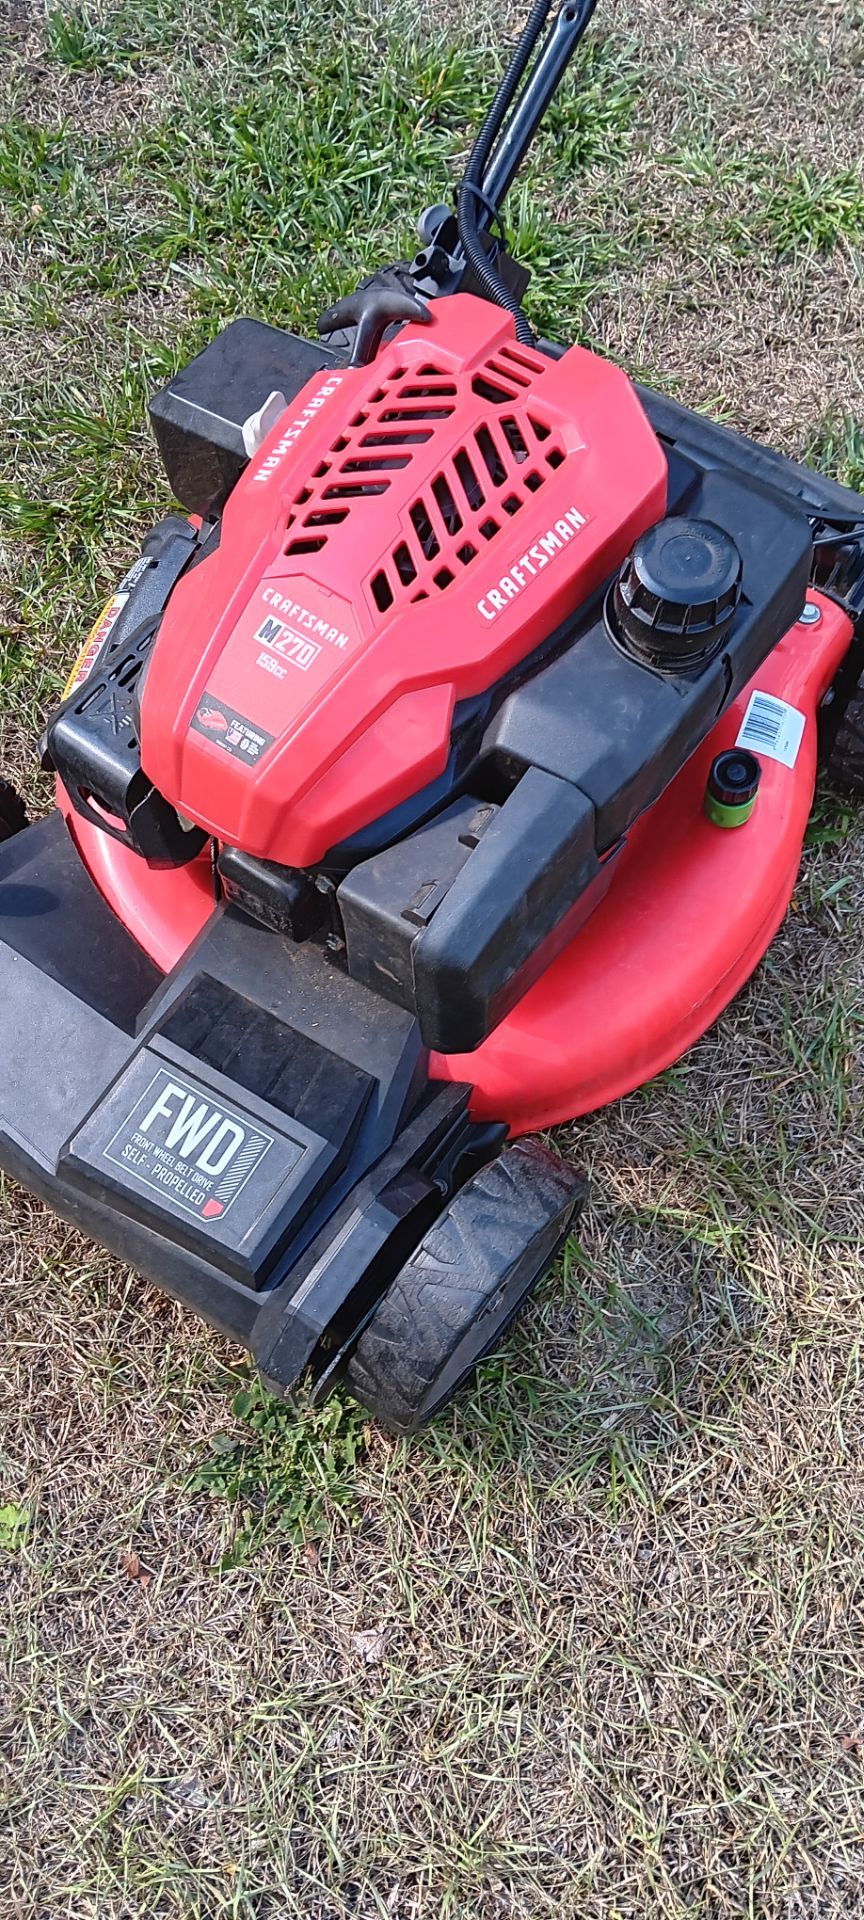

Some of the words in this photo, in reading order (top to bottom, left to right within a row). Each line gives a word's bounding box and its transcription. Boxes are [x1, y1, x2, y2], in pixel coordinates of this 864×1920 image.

[253, 377, 343, 481] CRAFTSMAN
[477, 506, 586, 620] CRAFTSMAN
[74, 607, 120, 682] DANGER
[262, 588, 349, 650] CRAFTSMAN
[131, 1132, 154, 1153] FRONT
[153, 1145, 175, 1167] WHEEL
[174, 1160, 195, 1177] BELT
[191, 1172, 214, 1192] DRIVE
[139, 1082, 245, 1176] FWD
[121, 1144, 147, 1167] SELF
[151, 1164, 205, 1205] PROPELLED
